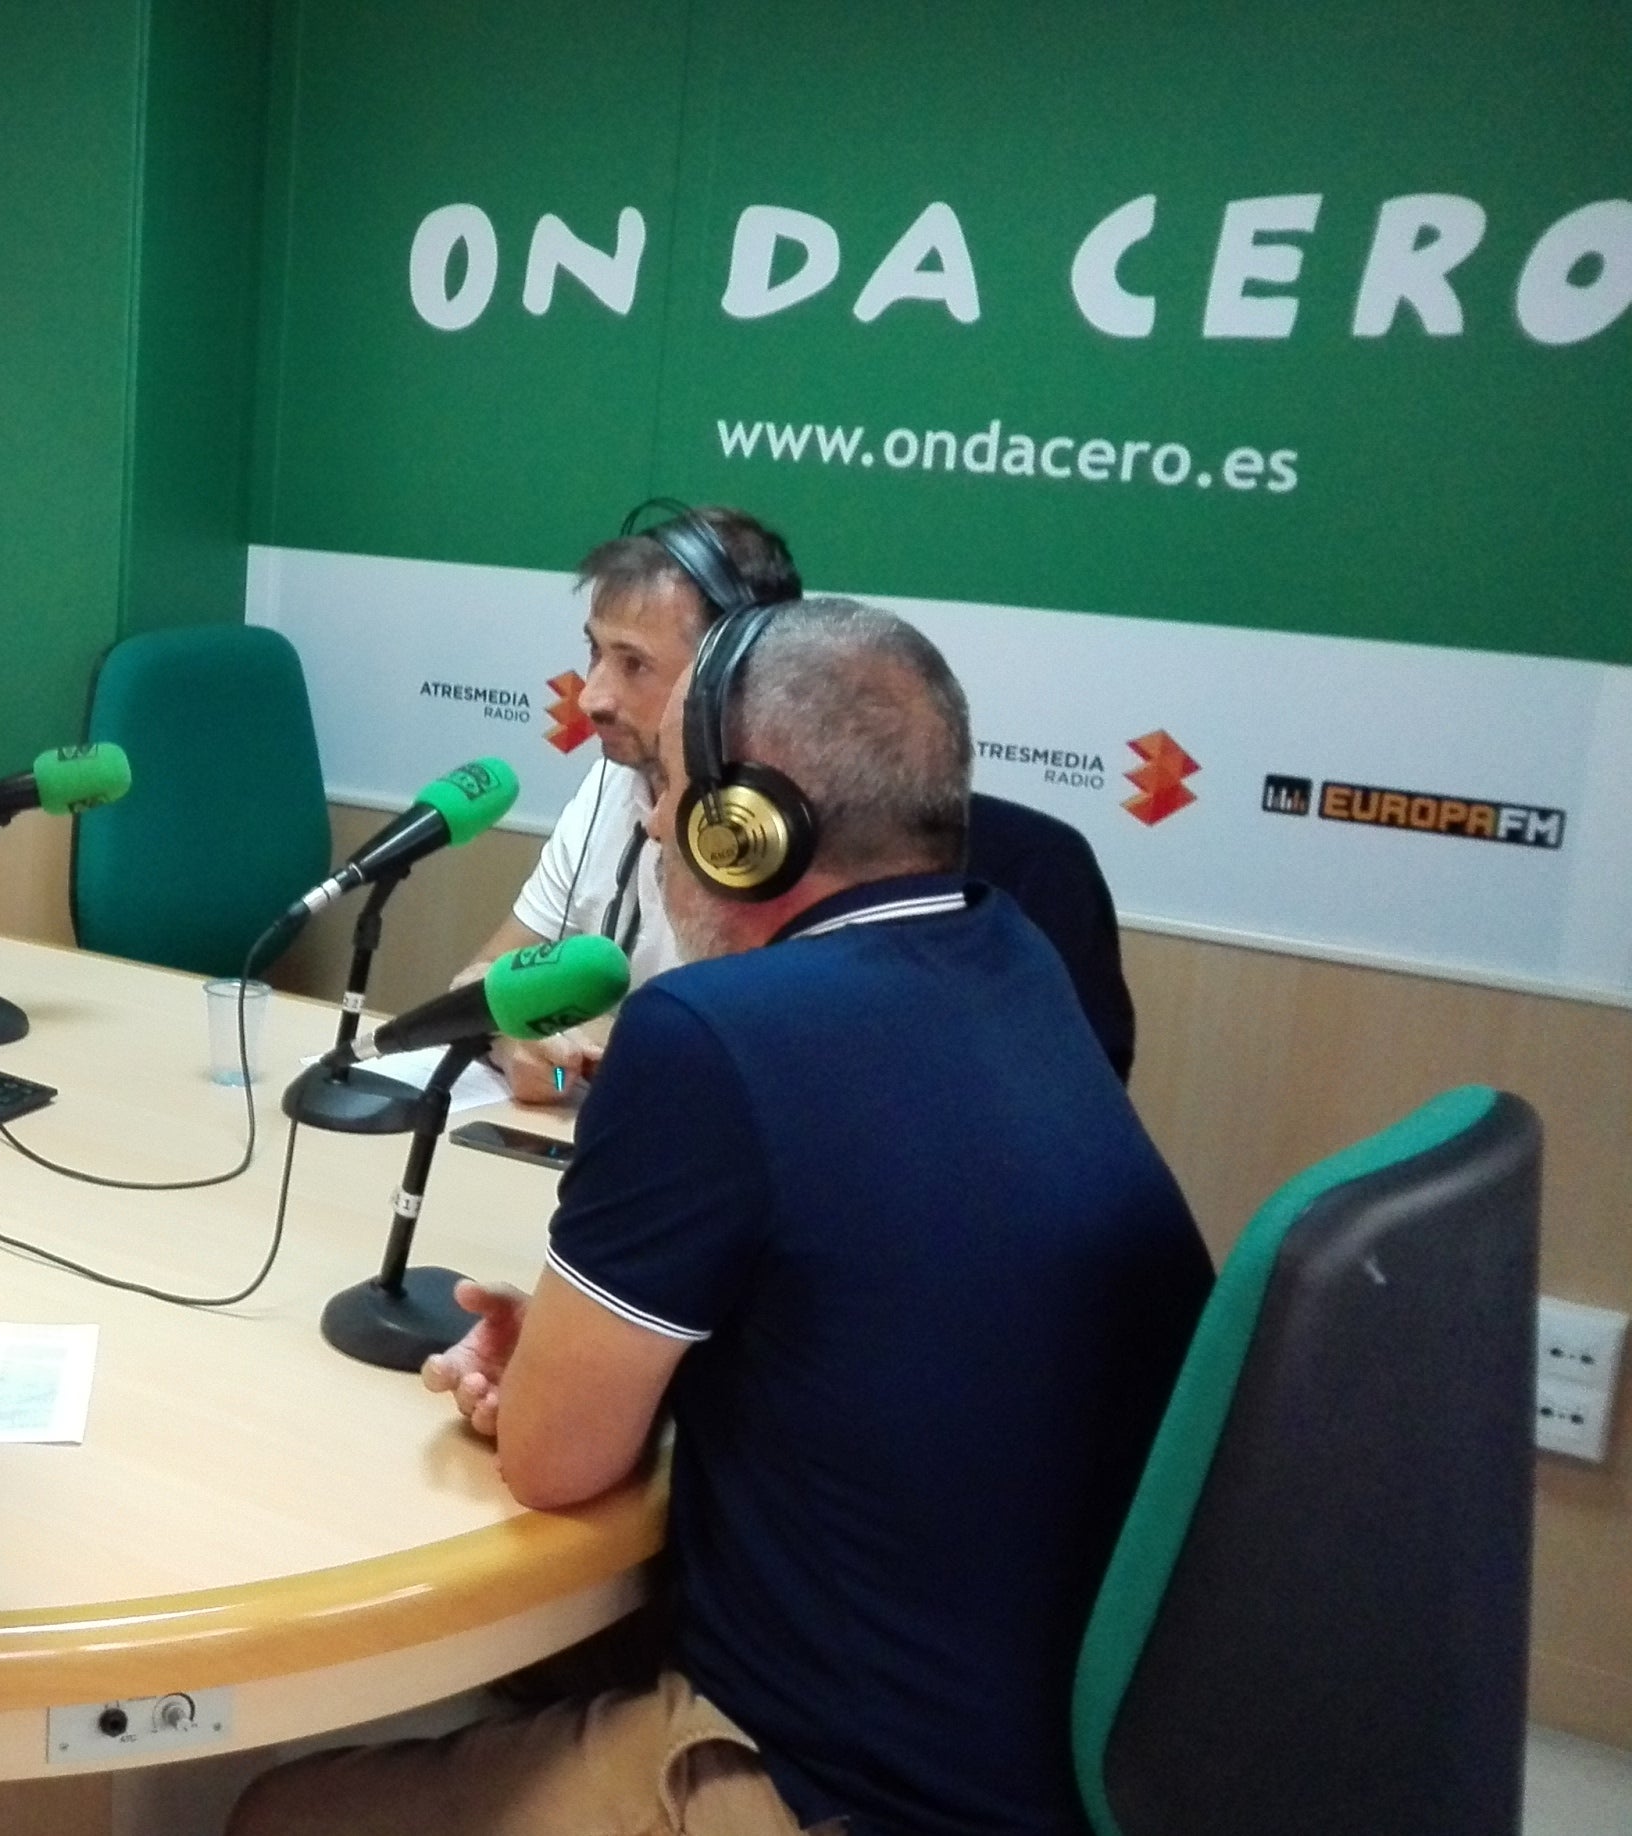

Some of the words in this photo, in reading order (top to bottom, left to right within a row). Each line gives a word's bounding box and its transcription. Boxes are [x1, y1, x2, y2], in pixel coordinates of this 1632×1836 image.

[1071, 193, 1632, 345] CERO
[716, 419, 1299, 493] www.ondacero.es
[419, 680, 531, 709] ATRESMEDIA
[483, 706, 531, 723] RADIO
[971, 740, 1105, 773] TRESMEDIA
[1043, 769, 1106, 790] RADIO
